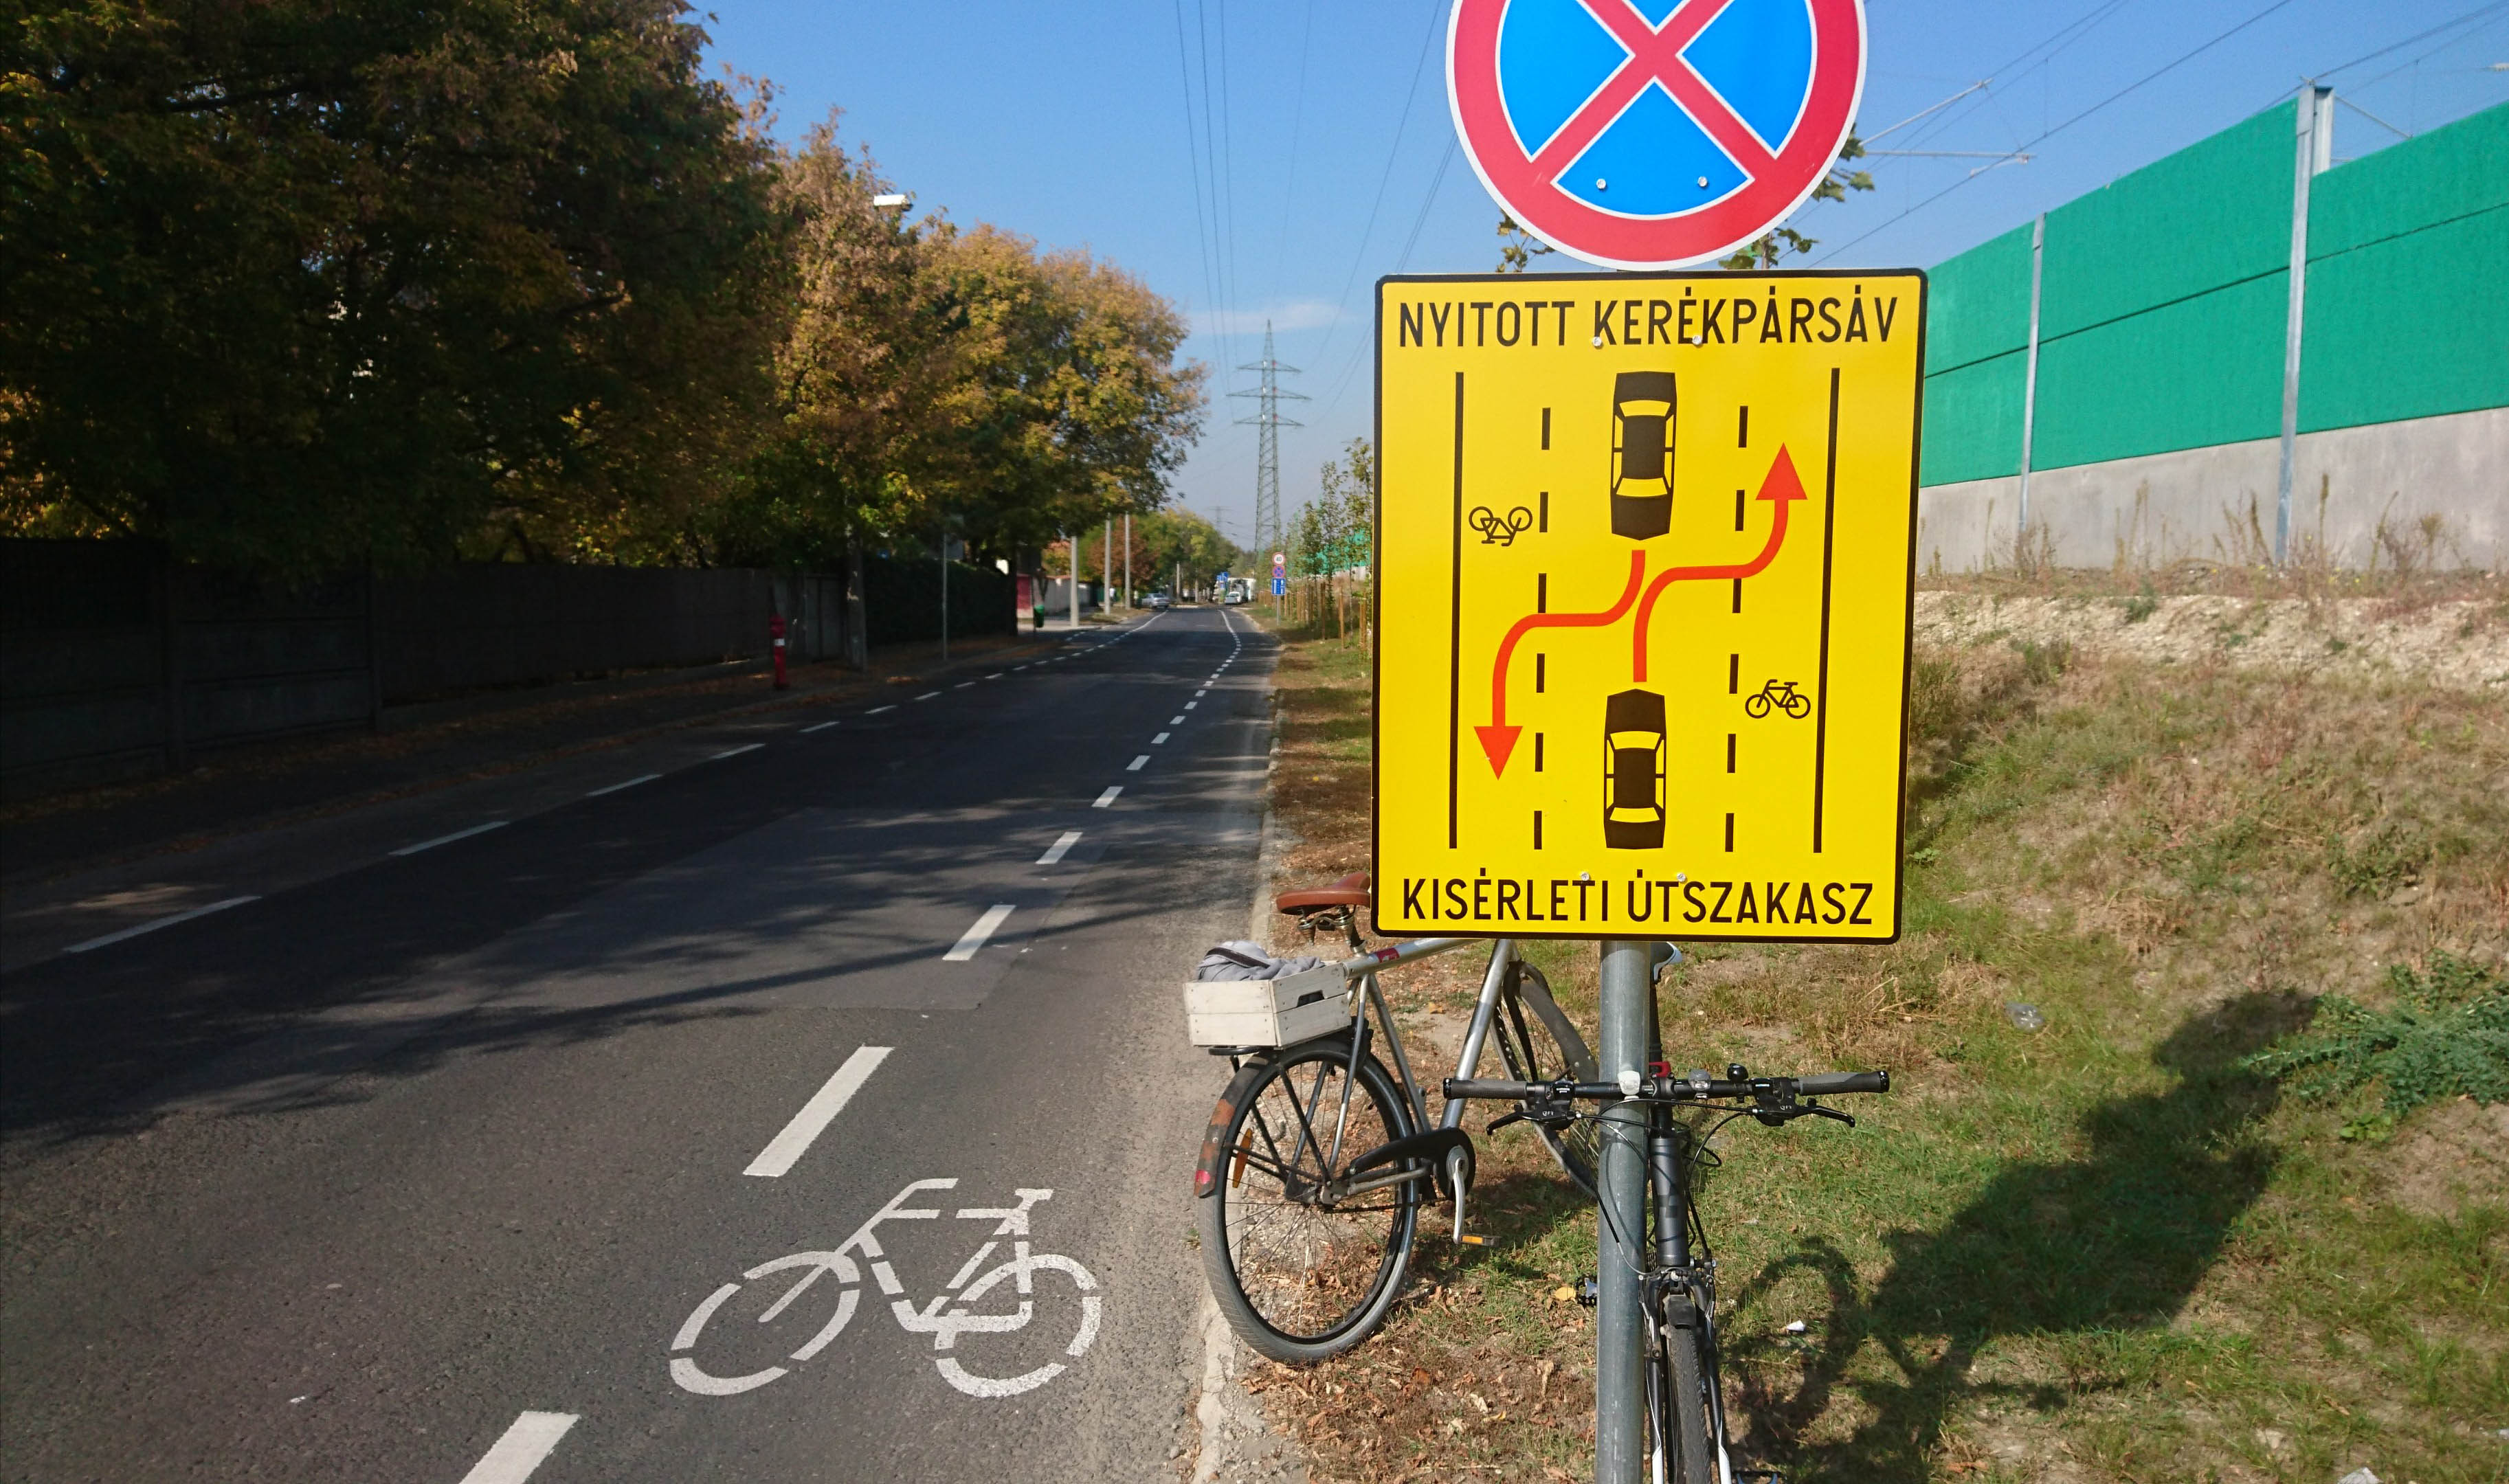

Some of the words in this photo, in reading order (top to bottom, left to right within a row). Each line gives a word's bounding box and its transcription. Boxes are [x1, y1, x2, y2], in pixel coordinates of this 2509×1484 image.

[1400, 301, 1576, 347] NYITOTT
[1594, 284, 1897, 345] KERÉKPÁRSÁV
[1403, 868, 1609, 922] KISÉRLETI
[1628, 869, 1873, 925] ÚTSZAKASZ
